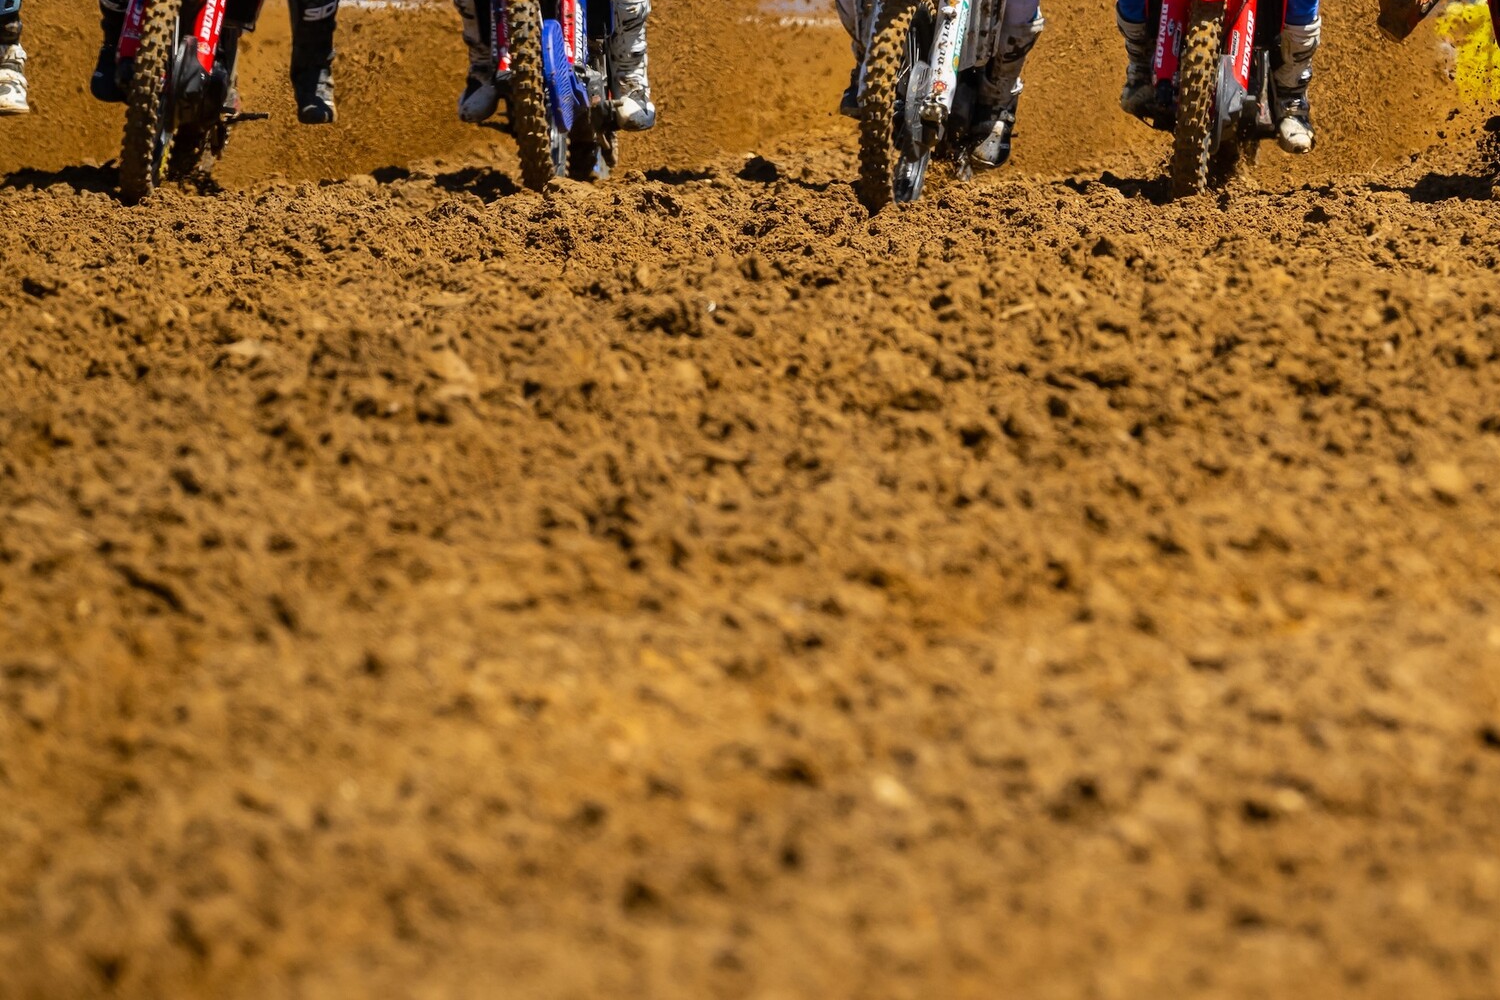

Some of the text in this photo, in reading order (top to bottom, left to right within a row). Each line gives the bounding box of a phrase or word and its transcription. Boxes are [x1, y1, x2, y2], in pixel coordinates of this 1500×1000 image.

[573, 2, 582, 63] DUNLOP
[937, 18, 951, 65] DUNLO
[954, 8, 968, 57] MOTOREX
[1156, 3, 1169, 68] DUNLOP
[1241, 10, 1254, 79] DUNLOP
